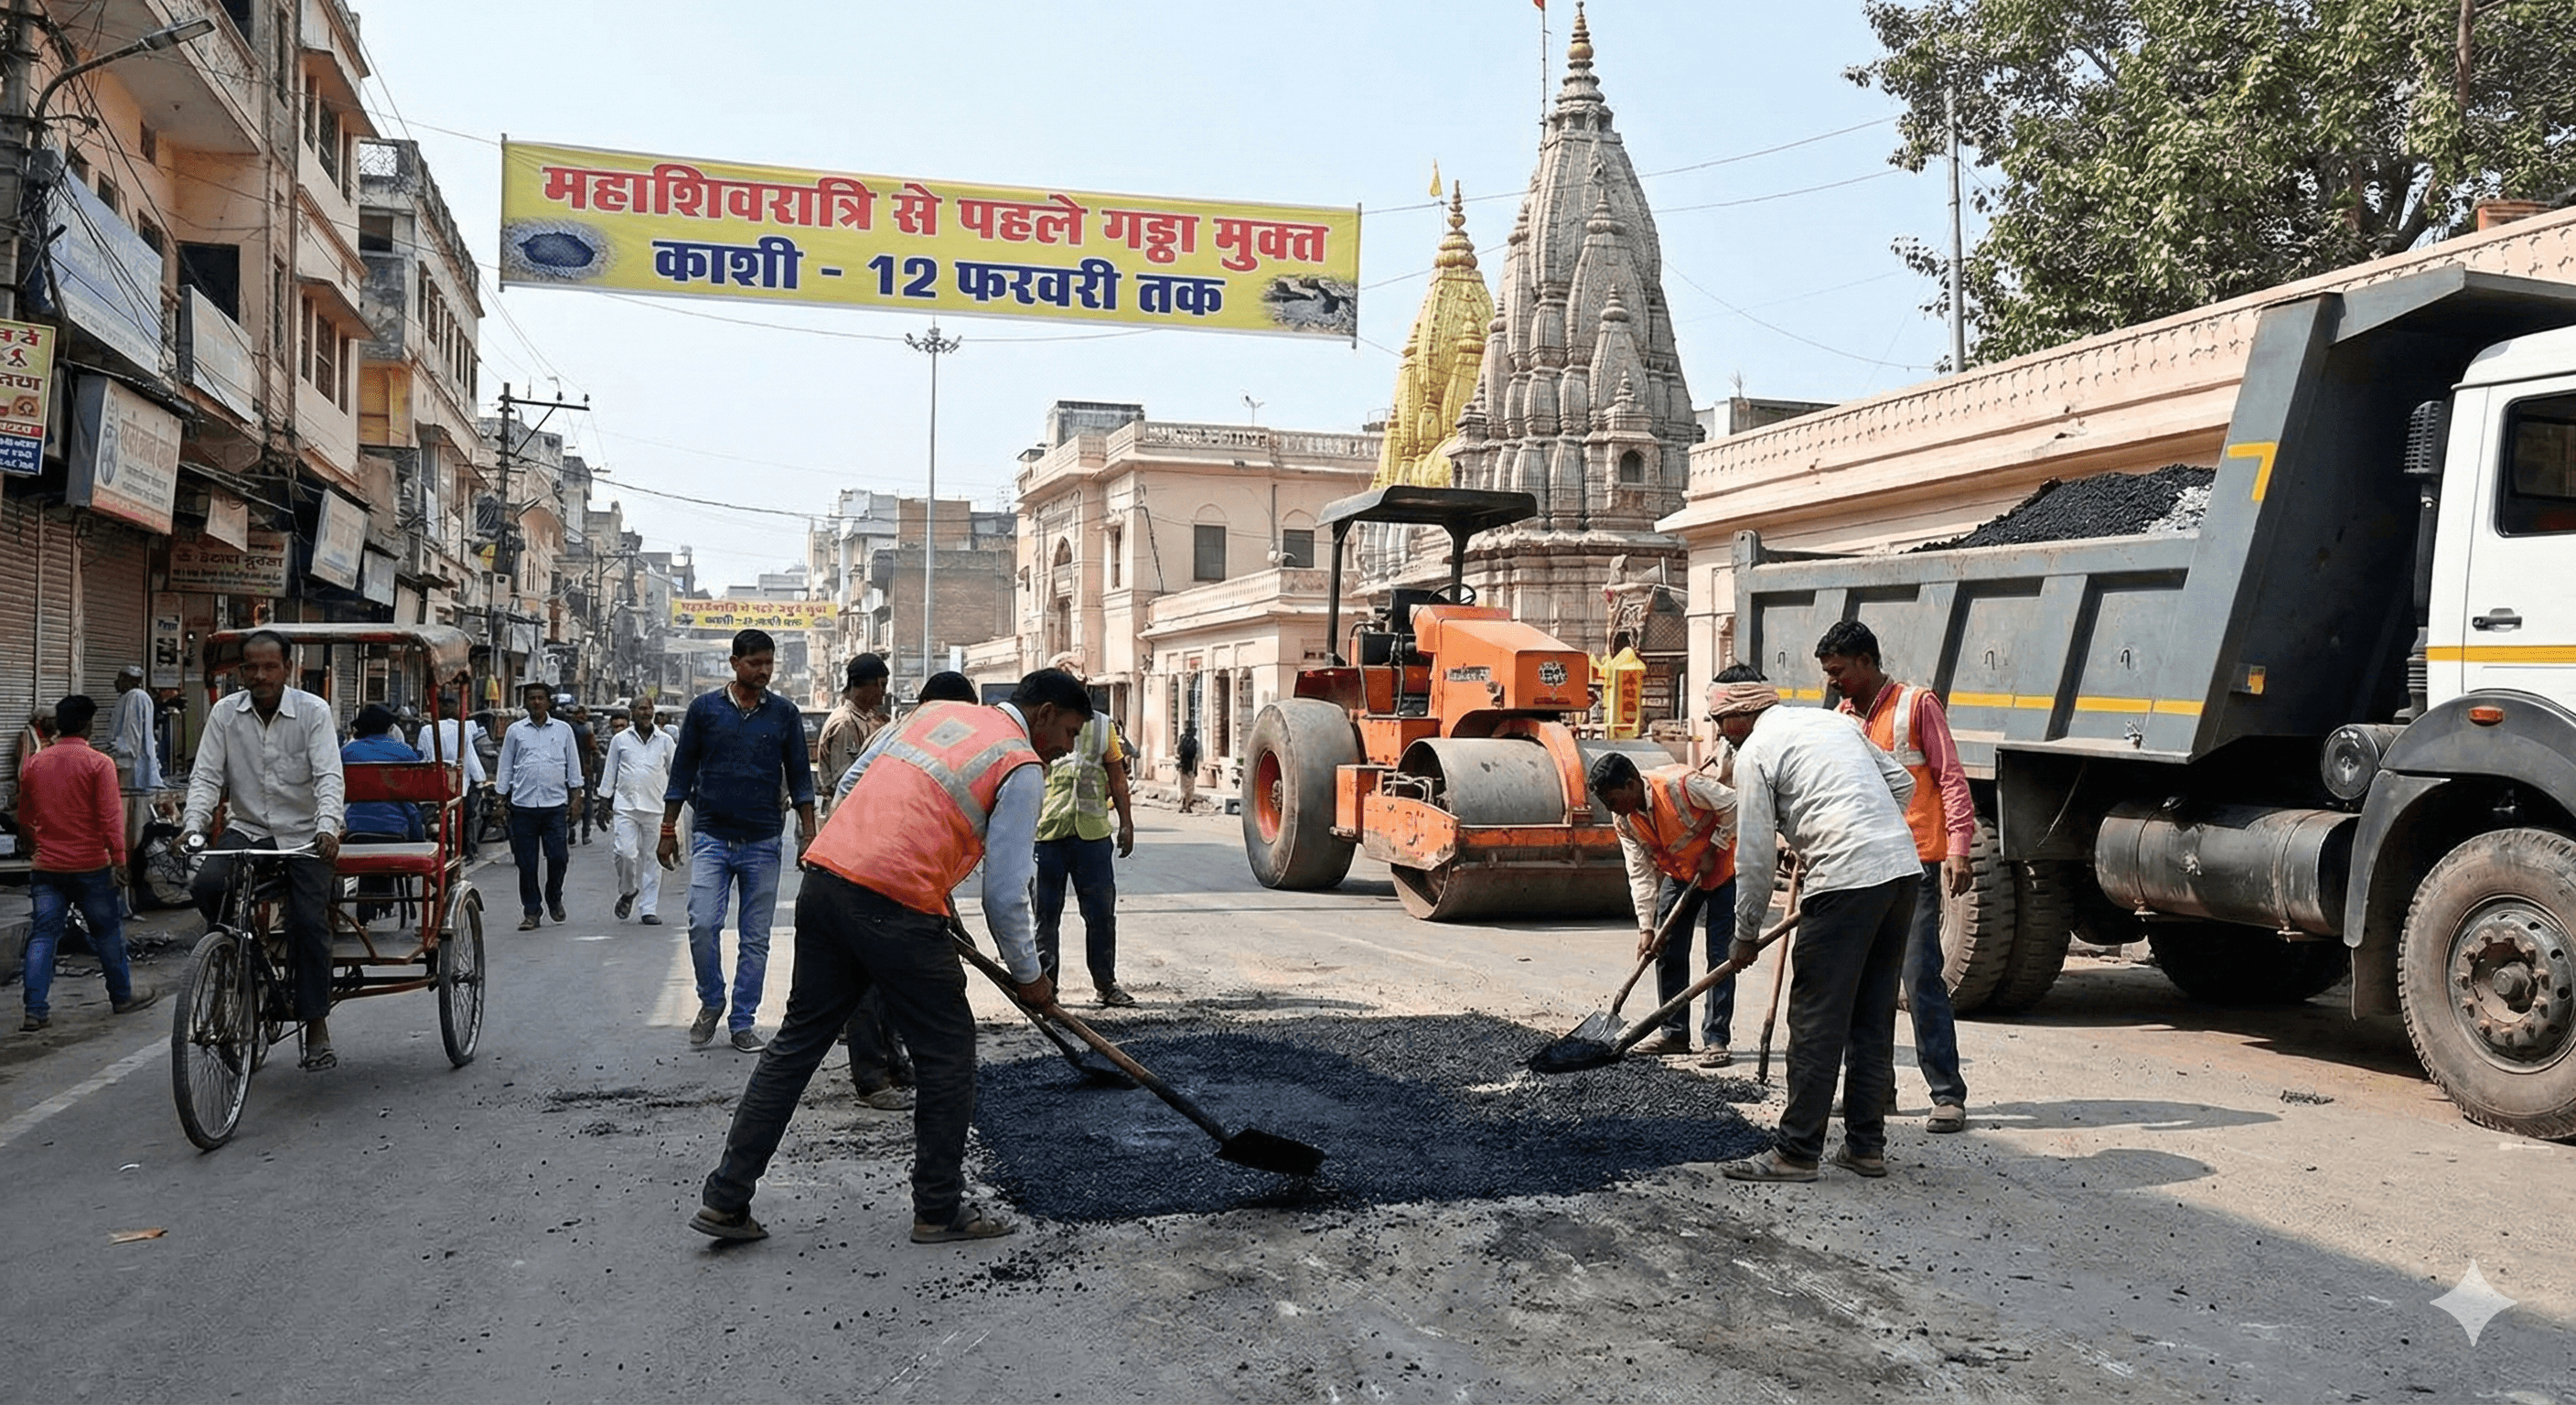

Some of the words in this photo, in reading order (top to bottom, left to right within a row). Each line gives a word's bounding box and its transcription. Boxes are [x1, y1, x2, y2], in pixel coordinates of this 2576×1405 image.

[542, 163, 877, 231] महाशिवरात्रि
[891, 182, 942, 236] से
[957, 194, 1088, 245] पहले
[1214, 217, 1330, 273] मुक्त
[652, 236, 804, 290] काशी
[868, 254, 938, 298] 12
[954, 257, 1122, 310] फरवरी
[1136, 274, 1226, 316] तक
